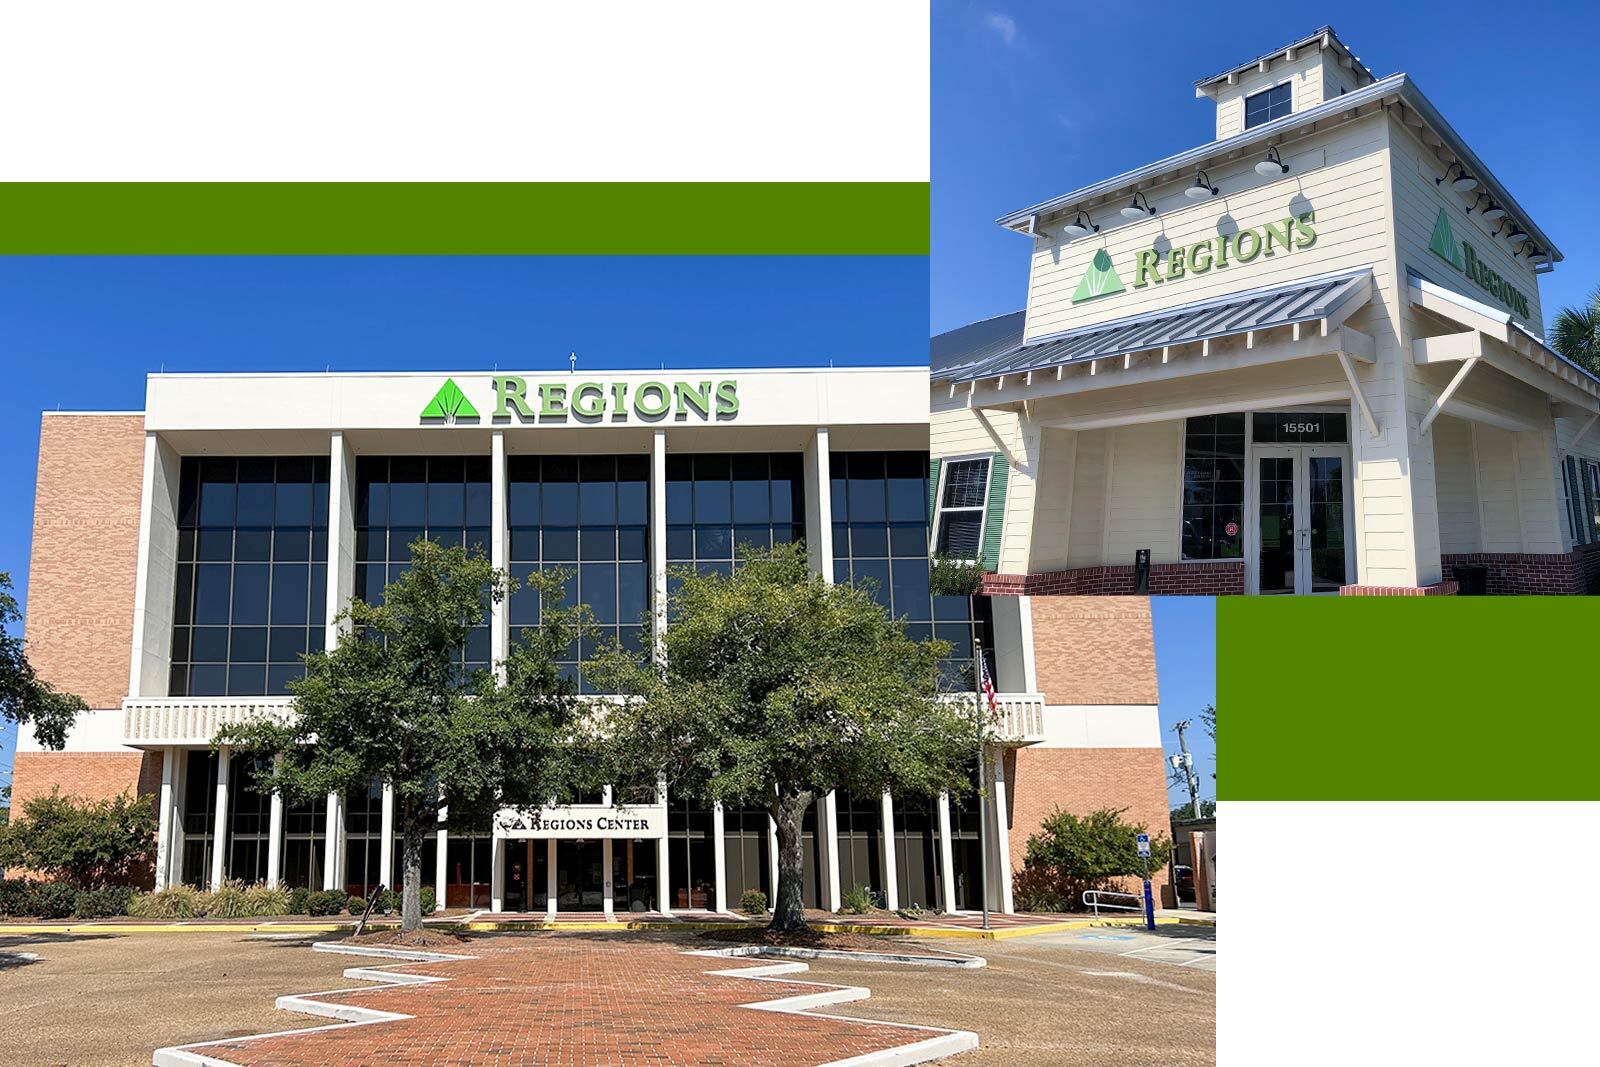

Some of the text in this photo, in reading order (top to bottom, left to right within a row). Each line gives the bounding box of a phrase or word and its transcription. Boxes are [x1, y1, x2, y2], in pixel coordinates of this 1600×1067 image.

[1133, 211, 1317, 288] REGIONS
[1463, 241, 1529, 319] REGIONS
[492, 376, 740, 424] REGIONS
[1282, 422, 1320, 433] 15501
[530, 817, 650, 831] REGIONS CENTER
